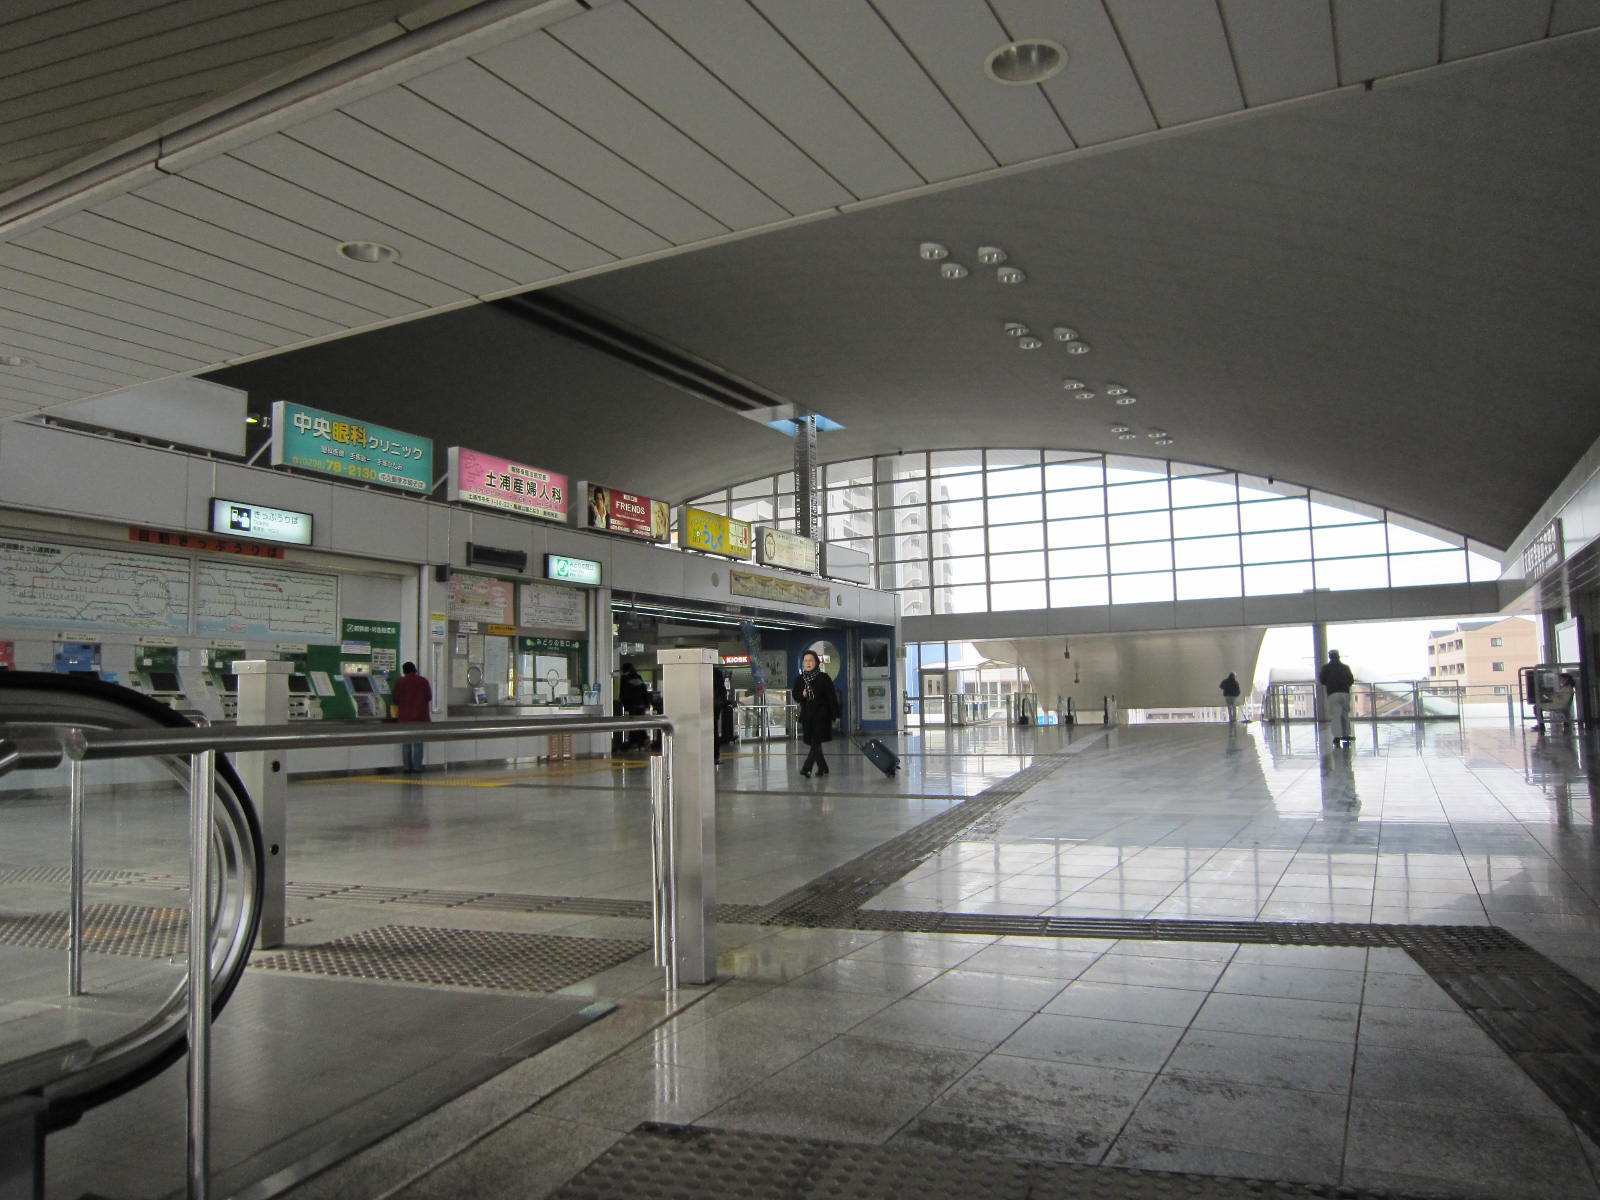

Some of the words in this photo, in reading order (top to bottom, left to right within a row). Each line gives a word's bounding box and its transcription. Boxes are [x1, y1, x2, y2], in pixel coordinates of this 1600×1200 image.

[293, 411, 424, 460] 中央眼科クリニック
[485, 471, 562, 504] 土浦産婦人科
[615, 501, 646, 515] FRIENDS
[254, 510, 299, 525] きっぷうりば
[536, 637, 571, 648] みどりの窓口
[726, 656, 748, 664] KIOSK
